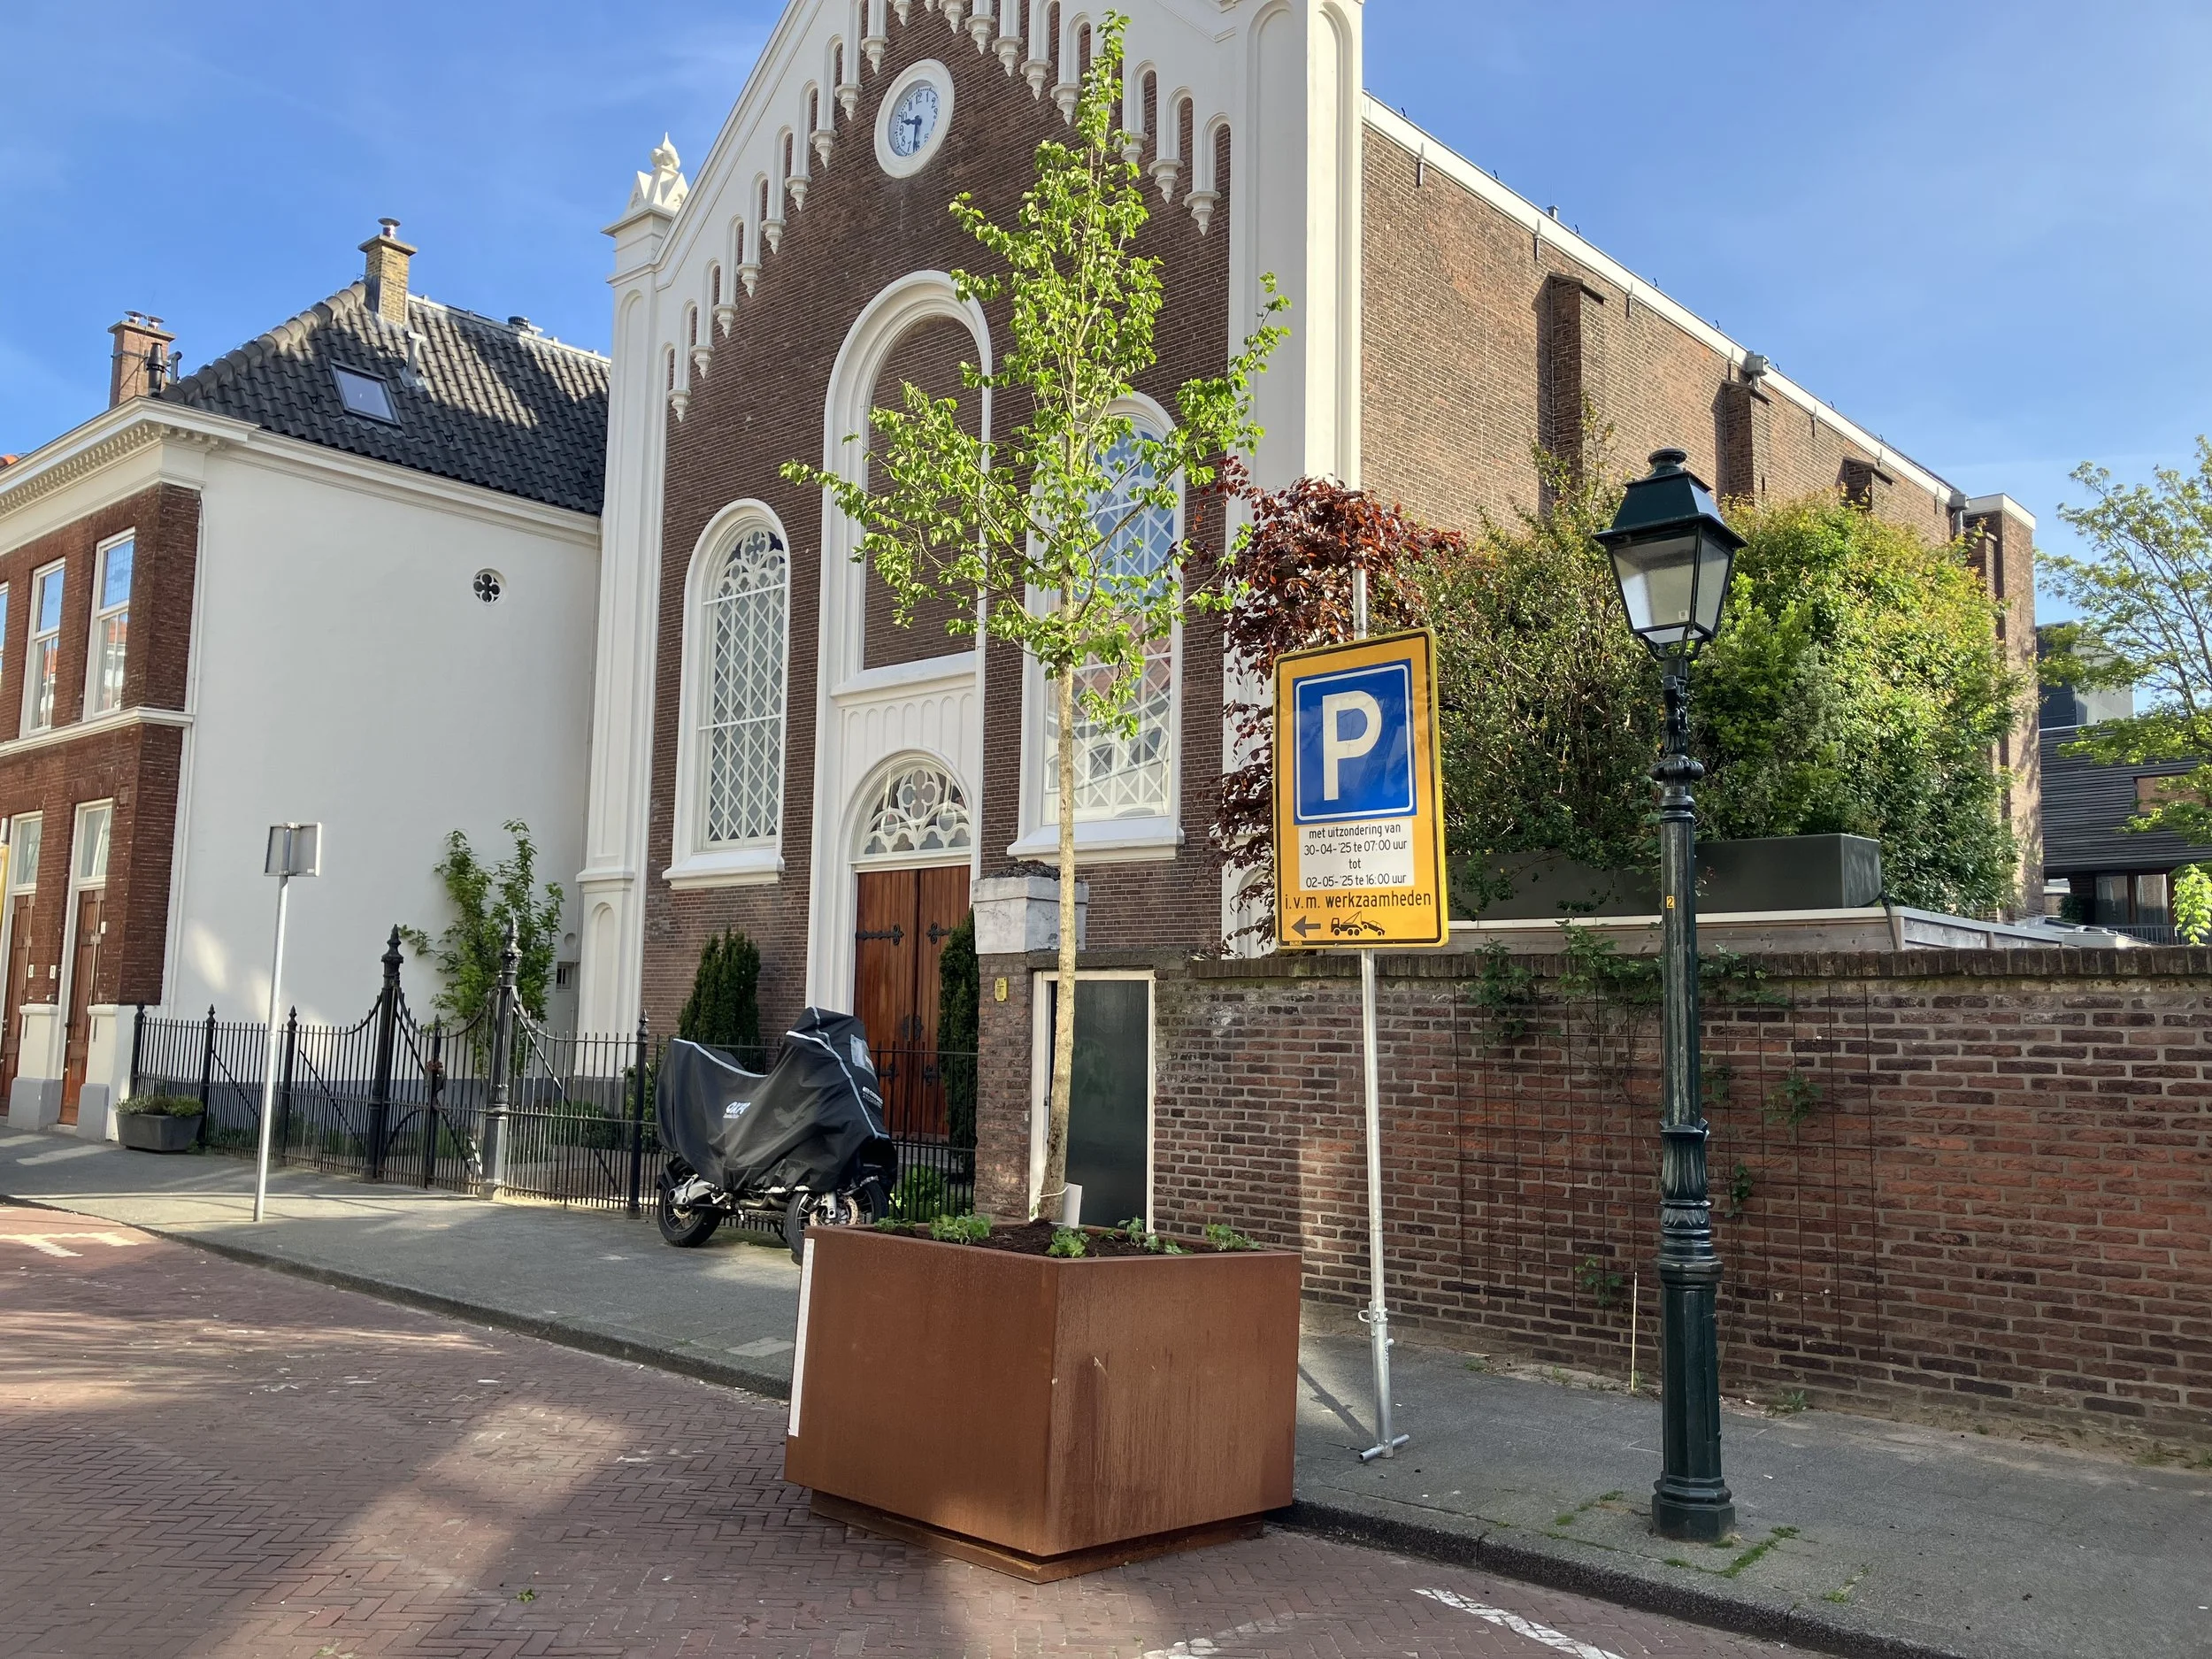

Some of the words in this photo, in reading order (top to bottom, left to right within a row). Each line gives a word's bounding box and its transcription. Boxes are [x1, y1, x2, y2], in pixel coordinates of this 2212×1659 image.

[915, 92, 923, 104] 12
[931, 96, 936, 110] 2
[901, 135, 906, 147] 8
[1322, 690, 1382, 801] P
[1309, 827, 1325, 840] met
[1328, 824, 1382, 838] uitzondering
[1385, 824, 1401, 833] van
[1354, 841, 1363, 853] te
[1363, 839, 1391, 851] 07:00
[1393, 840, 1407, 850] uur
[1348, 858, 1361, 870] tot
[1355, 875, 1363, 886] te
[1365, 873, 1390, 885] 16:00
[1392, 874, 1406, 884] uur
[1285, 894, 1321, 910] i.v.m.
[1325, 890, 1432, 909] werkzaamheden
[1667, 897, 1673, 907] 2
